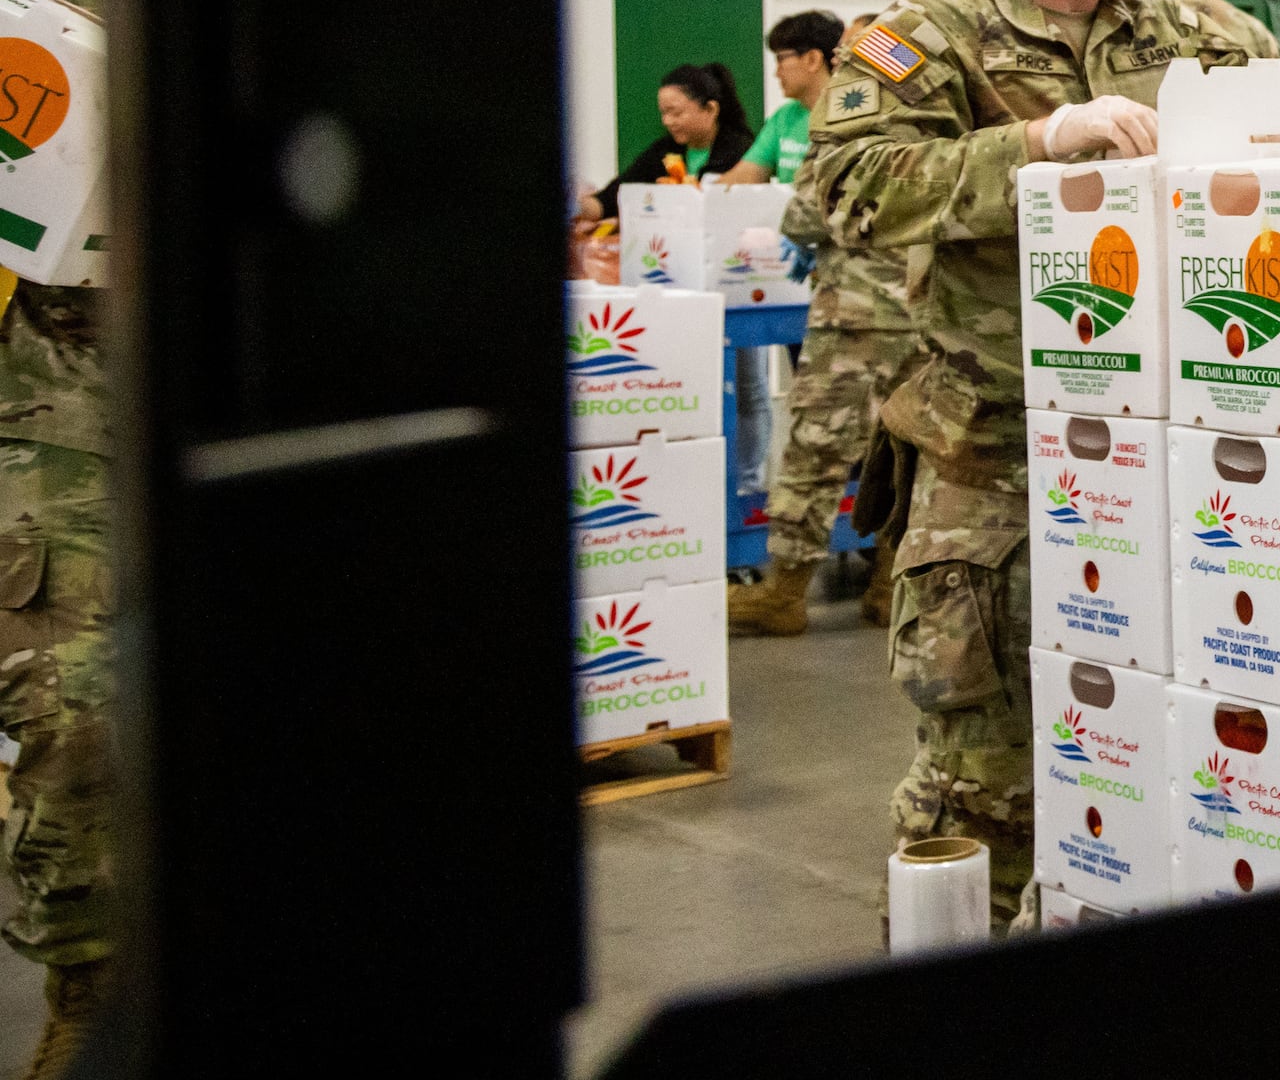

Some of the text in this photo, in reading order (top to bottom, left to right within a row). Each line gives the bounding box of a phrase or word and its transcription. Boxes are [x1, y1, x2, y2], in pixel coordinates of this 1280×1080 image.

[1016, 54, 1053, 70] PRICE
[1149, 43, 1181, 63] ARMY
[1042, 353, 1127, 369] PREMIUM BROCCOLI
[1193, 364, 1234, 381] PREMIUM
[571, 395, 699, 417] BROCCOLI
[1240, 515, 1269, 532] Pacific
[1077, 532, 1139, 555] BROCCOLI
[576, 539, 703, 569] BROCCOLI
[1190, 556, 1226, 577] California
[1203, 636, 1228, 652] PACIFIC
[1229, 642, 1251, 657] COAST
[1214, 654, 1230, 665] SANTA
[580, 681, 705, 717] BROCCOLI
[1079, 771, 1144, 802] BROCCOLI
[1238, 779, 1268, 799] Pacific
